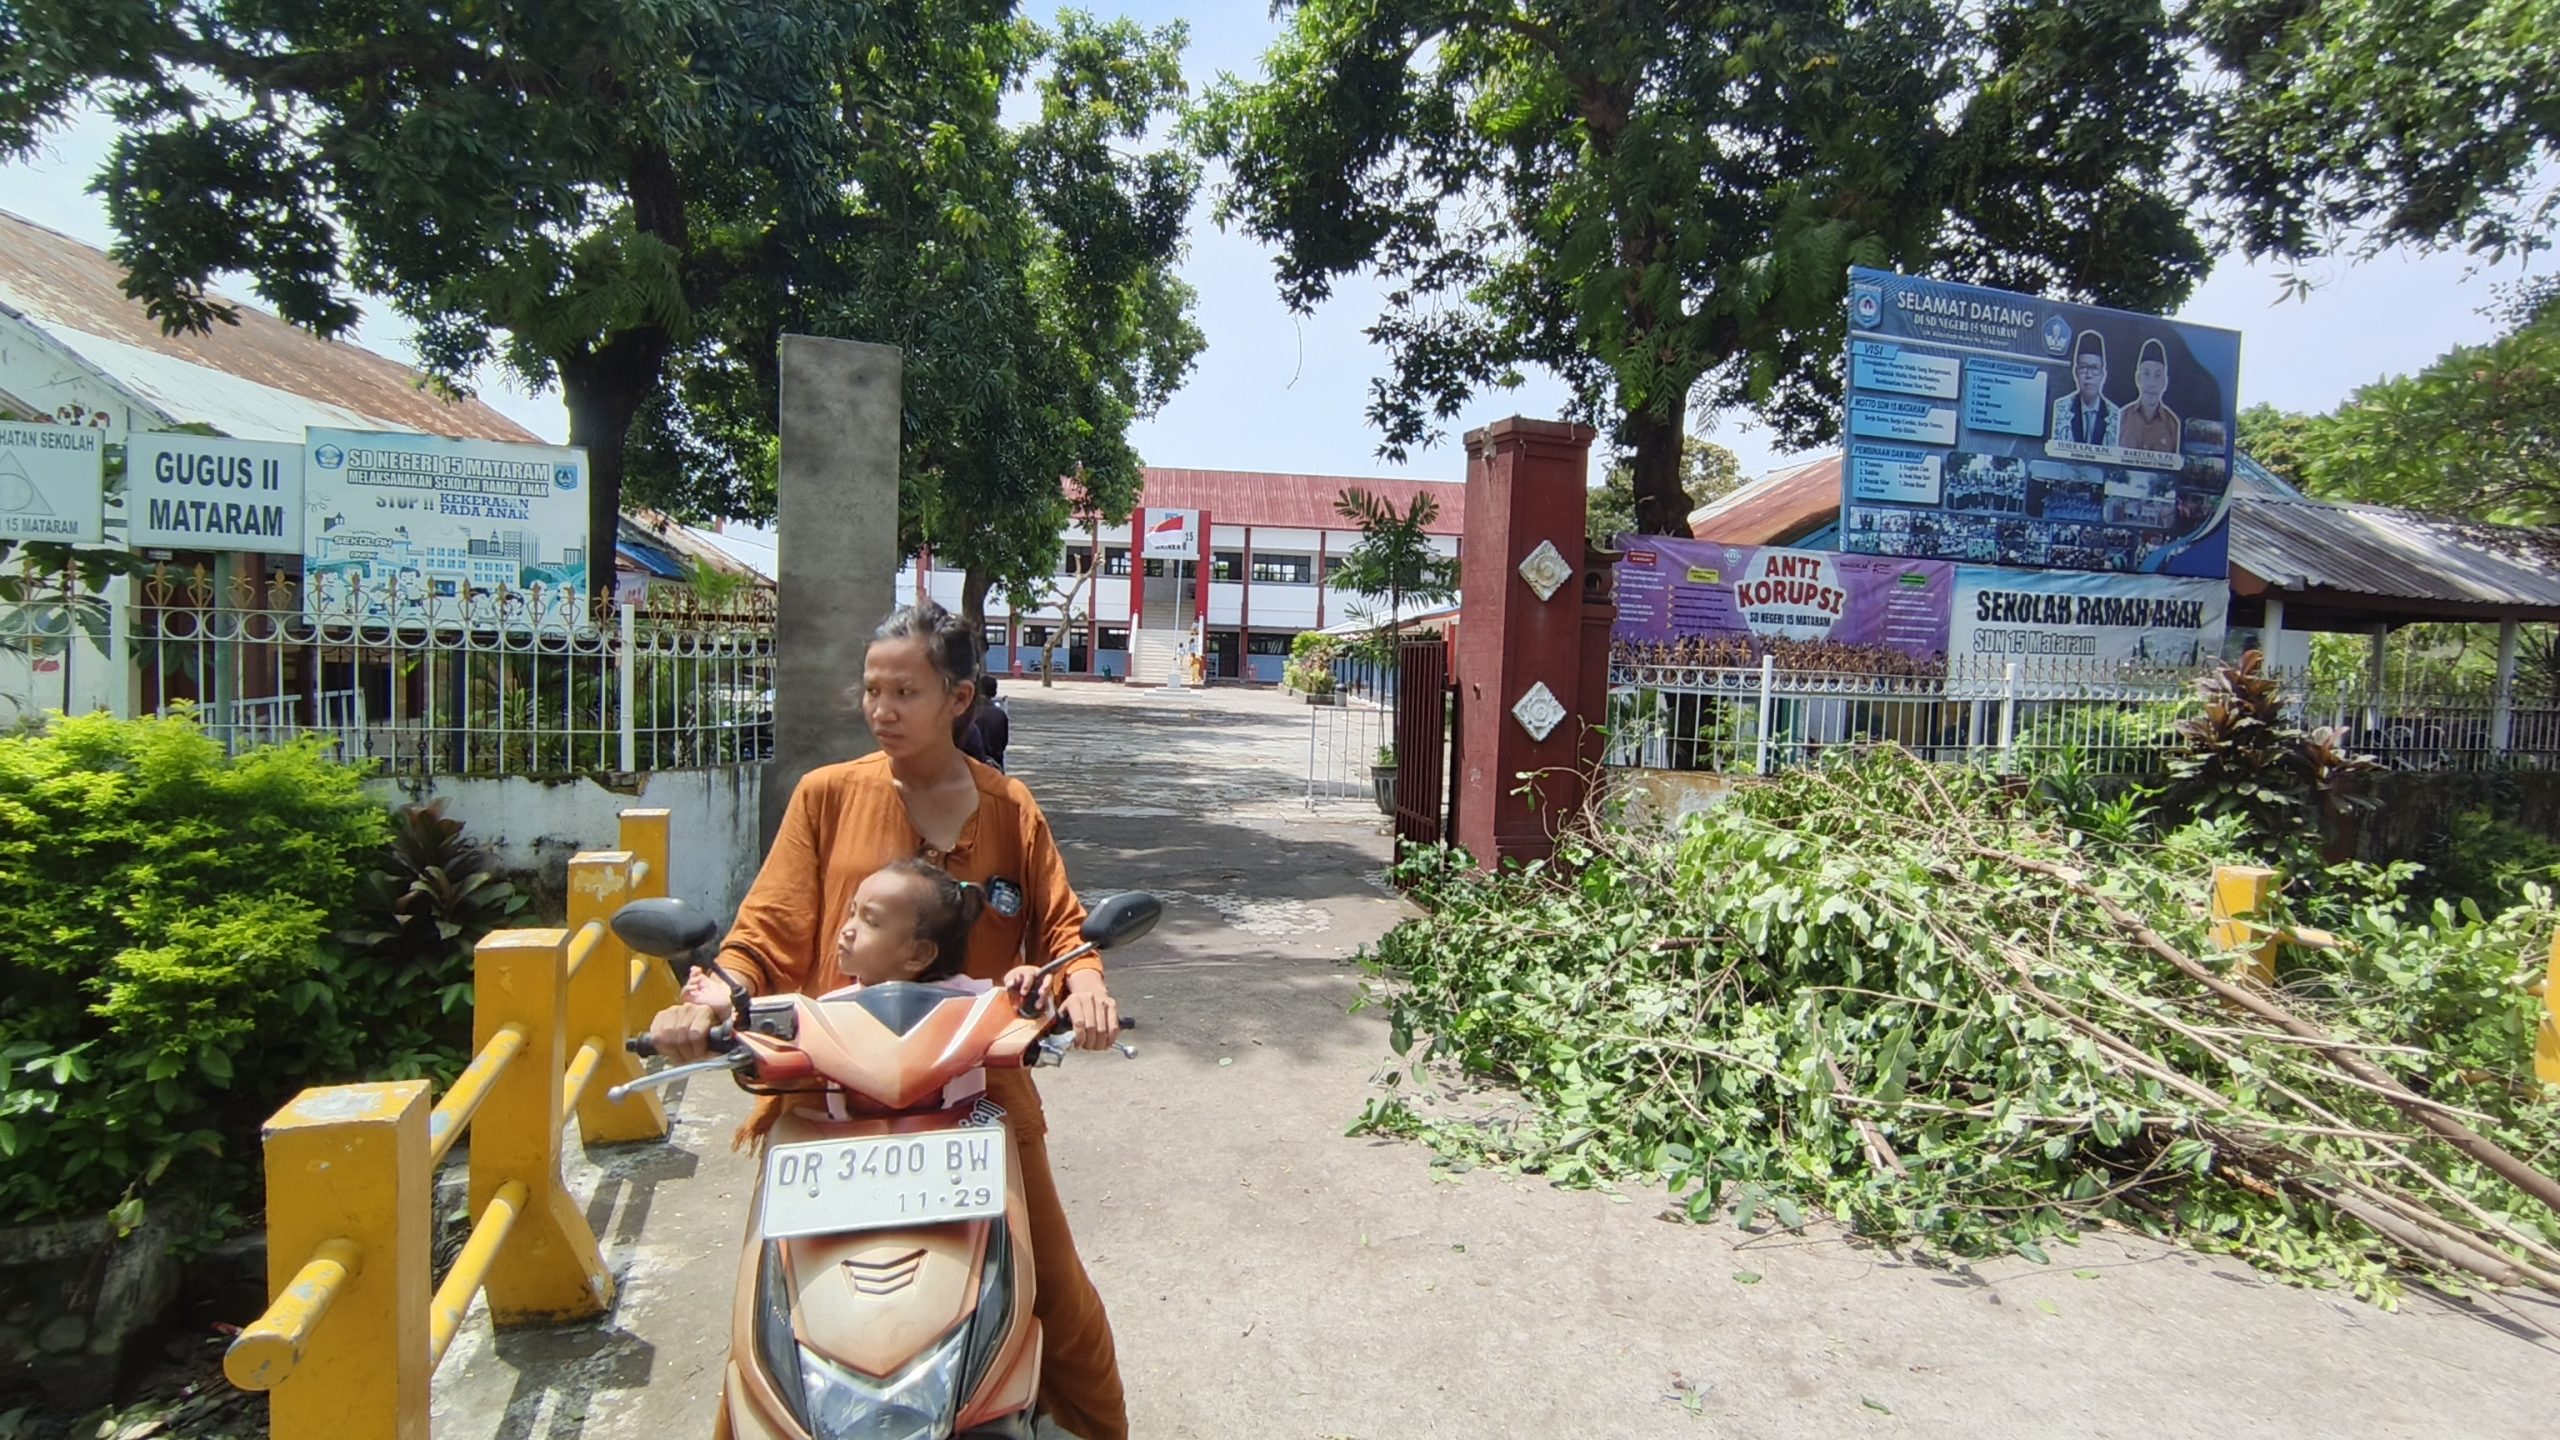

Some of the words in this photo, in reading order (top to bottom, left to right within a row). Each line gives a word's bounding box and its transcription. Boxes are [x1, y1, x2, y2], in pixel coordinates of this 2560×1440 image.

[1898, 291, 1967, 317] SELAMAT
[1971, 302, 2034, 328] DATANG
[1914, 314, 1924, 325] DI
[1925, 315, 1937, 326] SD
[1939, 317, 1969, 331] NEGERI
[1980, 323, 2017, 339] MATARAM
[1864, 344, 1884, 356] VISI
[1855, 398, 1876, 409] MOTTO
[40, 432, 95, 451] SEKOLAH
[155, 451, 253, 489] GUGUS
[262, 459, 279, 491] II
[348, 449, 373, 468] SD
[376, 451, 440, 473] NEGERI
[441, 456, 464, 475] 15
[466, 458, 549, 481] MATARAM
[348, 469, 433, 488] MELAKSANAKAN
[434, 475, 480, 492] SEKOLAH
[482, 480, 519, 495] RAMAH
[520, 483, 549, 497] ANAK
[376, 495, 419, 510] STOP
[440, 504, 481, 517] PADA
[485, 506, 529, 520] ANAK
[6, 518, 18, 531] 15
[22, 519, 78, 534] MATARAM
[149, 498, 284, 537] MATARAM
[1765, 555, 1821, 581] ANTI
[1738, 580, 1843, 615] KORUPSI
[1976, 590, 2072, 625] SEKOLAH
[2076, 596, 2150, 627] RAMAH
[2151, 599, 2204, 629] ANAK
[1750, 611, 1760, 623] SD
[1760, 613, 1785, 625] NEGERI
[1786, 614, 1794, 625] 15
[1796, 615, 1831, 627] MATARAM
[1973, 628, 2006, 654] SDN
[2008, 630, 2027, 654] 15
[2028, 631, 2096, 656] Mataram
[779, 1152, 822, 1186] DR
[838, 1142, 925, 1181] 3400
[946, 1138, 989, 1172] BW
